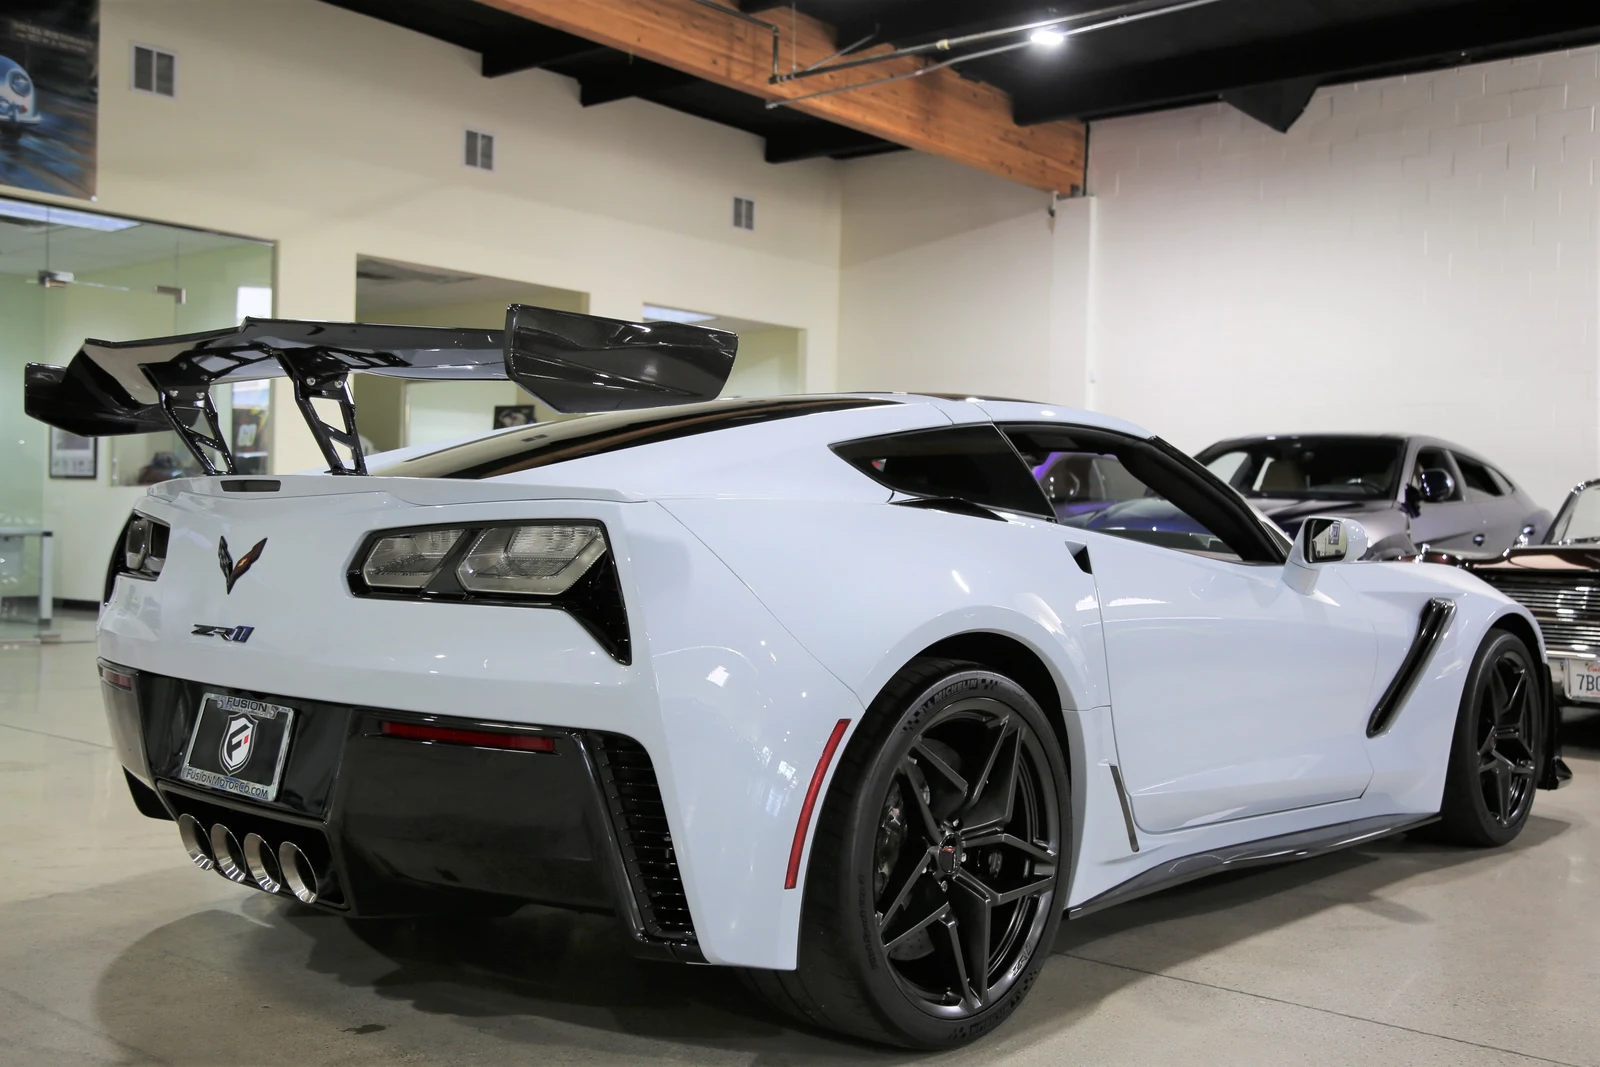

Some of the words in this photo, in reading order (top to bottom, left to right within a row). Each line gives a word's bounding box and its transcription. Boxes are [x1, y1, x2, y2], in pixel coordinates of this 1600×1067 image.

[191, 623, 255, 643] ZR1
[934, 679, 978, 703] MICHELIN
[226, 697, 267, 712] FUSION
